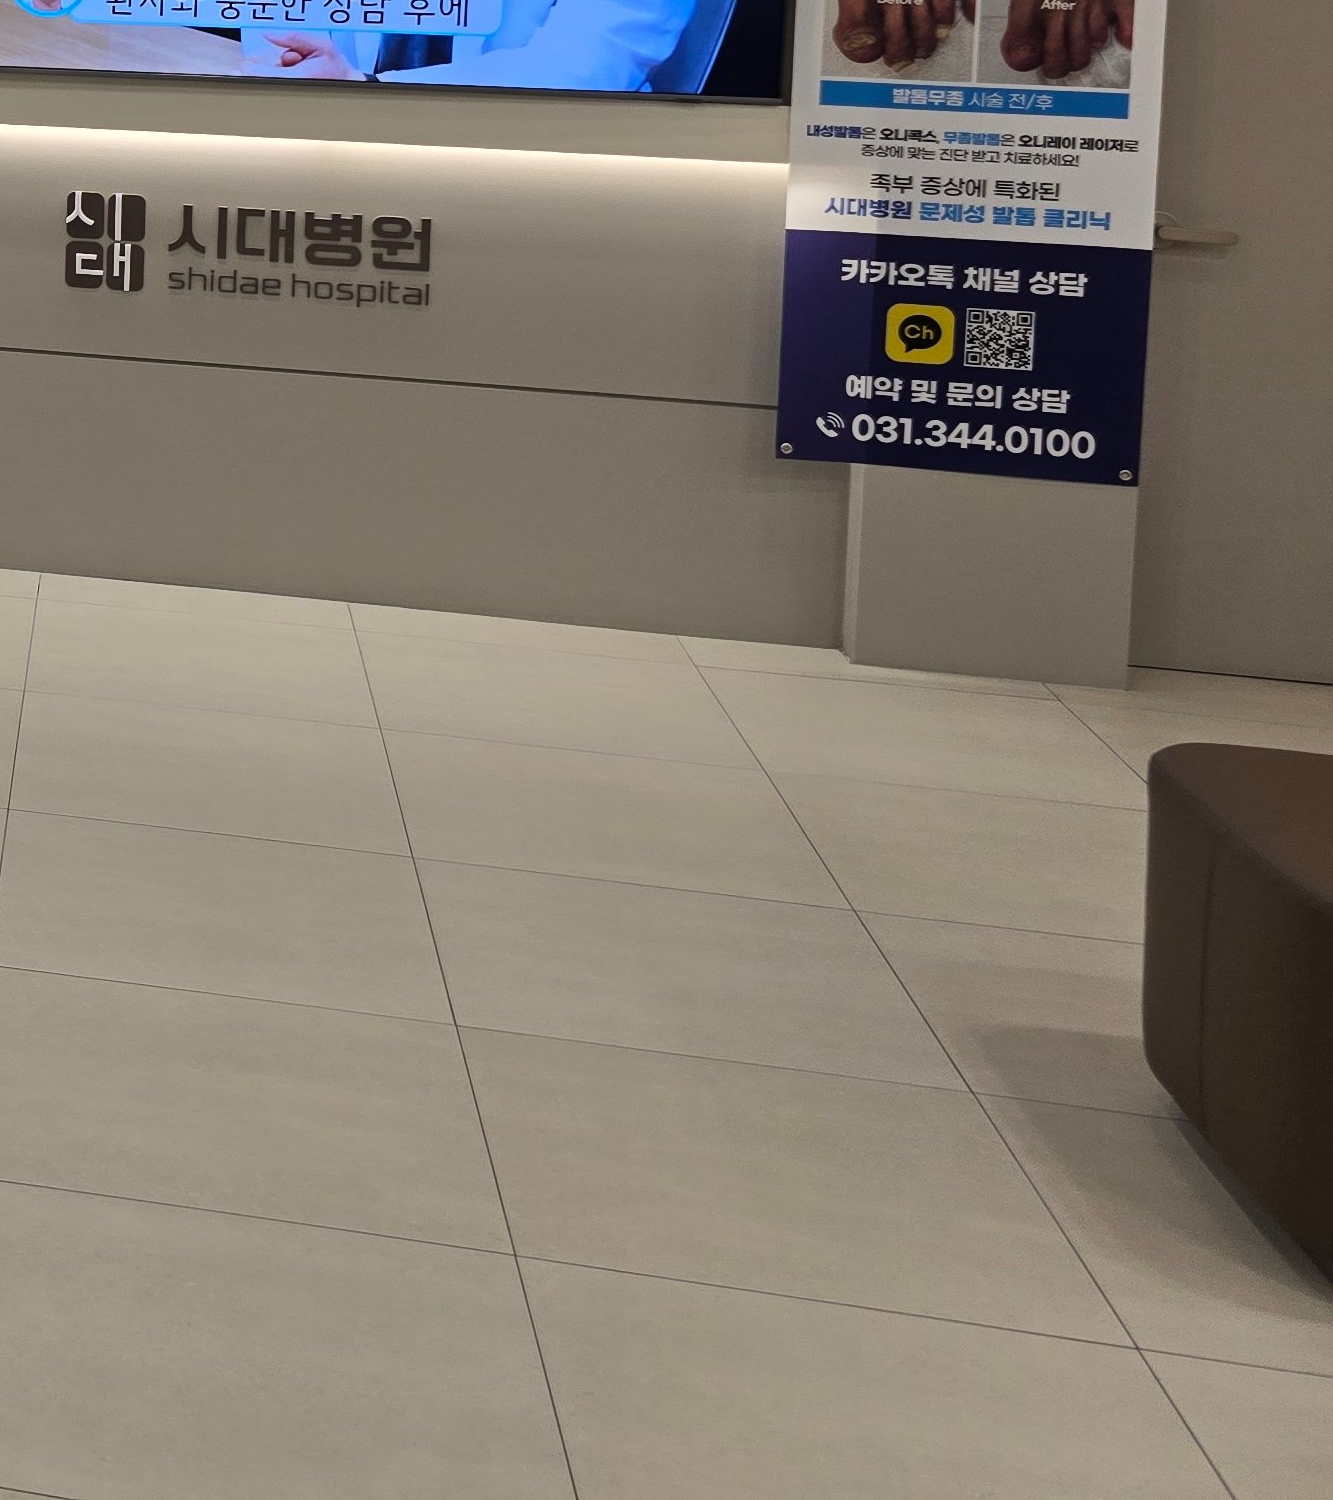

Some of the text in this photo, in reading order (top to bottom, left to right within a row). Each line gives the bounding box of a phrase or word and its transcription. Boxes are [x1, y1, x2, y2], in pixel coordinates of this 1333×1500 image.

[1041, 0, 1076, 11] After
[892, 88, 1054, 111] 발톱무좀 시술 전/후
[869, 172, 1061, 202] 족부 증상에 특화된
[824, 196, 1112, 231] 시대병원 문제성 발톱 클리닉
[168, 203, 432, 273] 시대병원
[168, 266, 430, 309] shidae hospital
[840, 259, 1089, 298] 카카오톡 채널 상담
[904, 324, 934, 340] Ch
[845, 374, 1071, 414] 예약 및 문의 상담
[851, 413, 1096, 459] 031.344.0100
